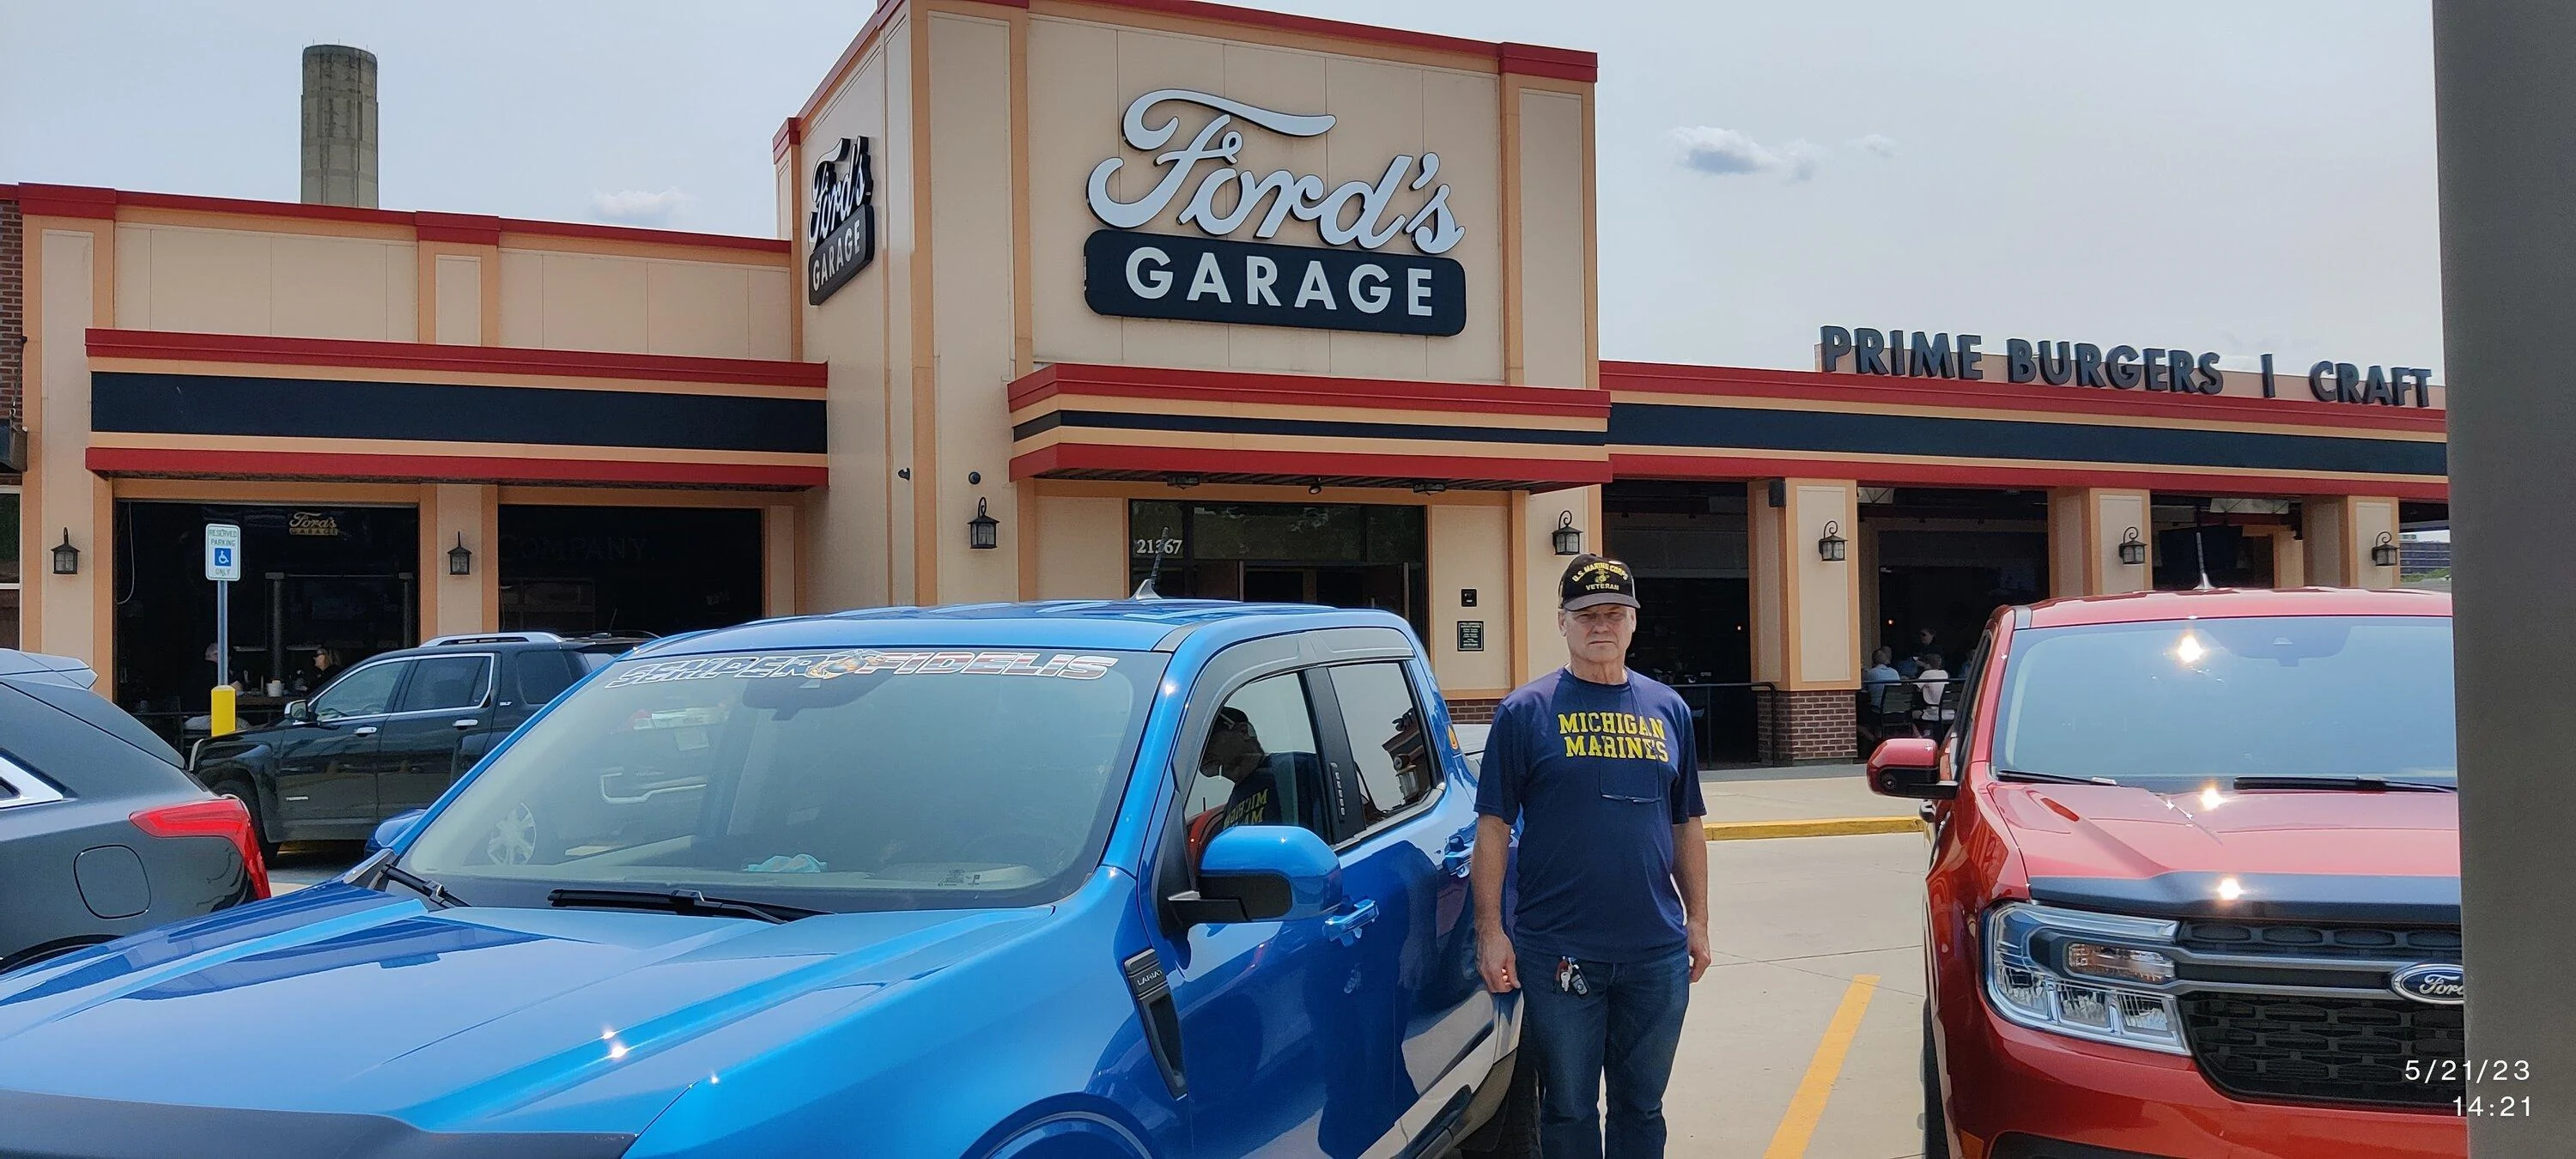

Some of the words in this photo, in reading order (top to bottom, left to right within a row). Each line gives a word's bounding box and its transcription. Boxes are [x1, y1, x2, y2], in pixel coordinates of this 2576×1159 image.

[1086, 88, 1466, 254] Ford's
[808, 136, 867, 252] Ford's
[812, 219, 861, 292] GARAGE
[1125, 246, 1433, 317] GARAGE
[1820, 325, 1984, 380] PRIME
[2007, 338, 2224, 395] BURGERS
[2309, 361, 2432, 408] CRAFT
[209, 529, 237, 537] RESERVED
[211, 538, 236, 547] PARKING
[215, 567, 230, 576] ONLY
[1583, 562, 1609, 573] MARINE
[1609, 565, 1629, 580] CORPS
[605, 655, 828, 688] SEMPER
[854, 652, 1118, 680] FIDELIS
[1558, 712, 1666, 740] MICHIGAN
[1564, 735, 1669, 762] MARINES
